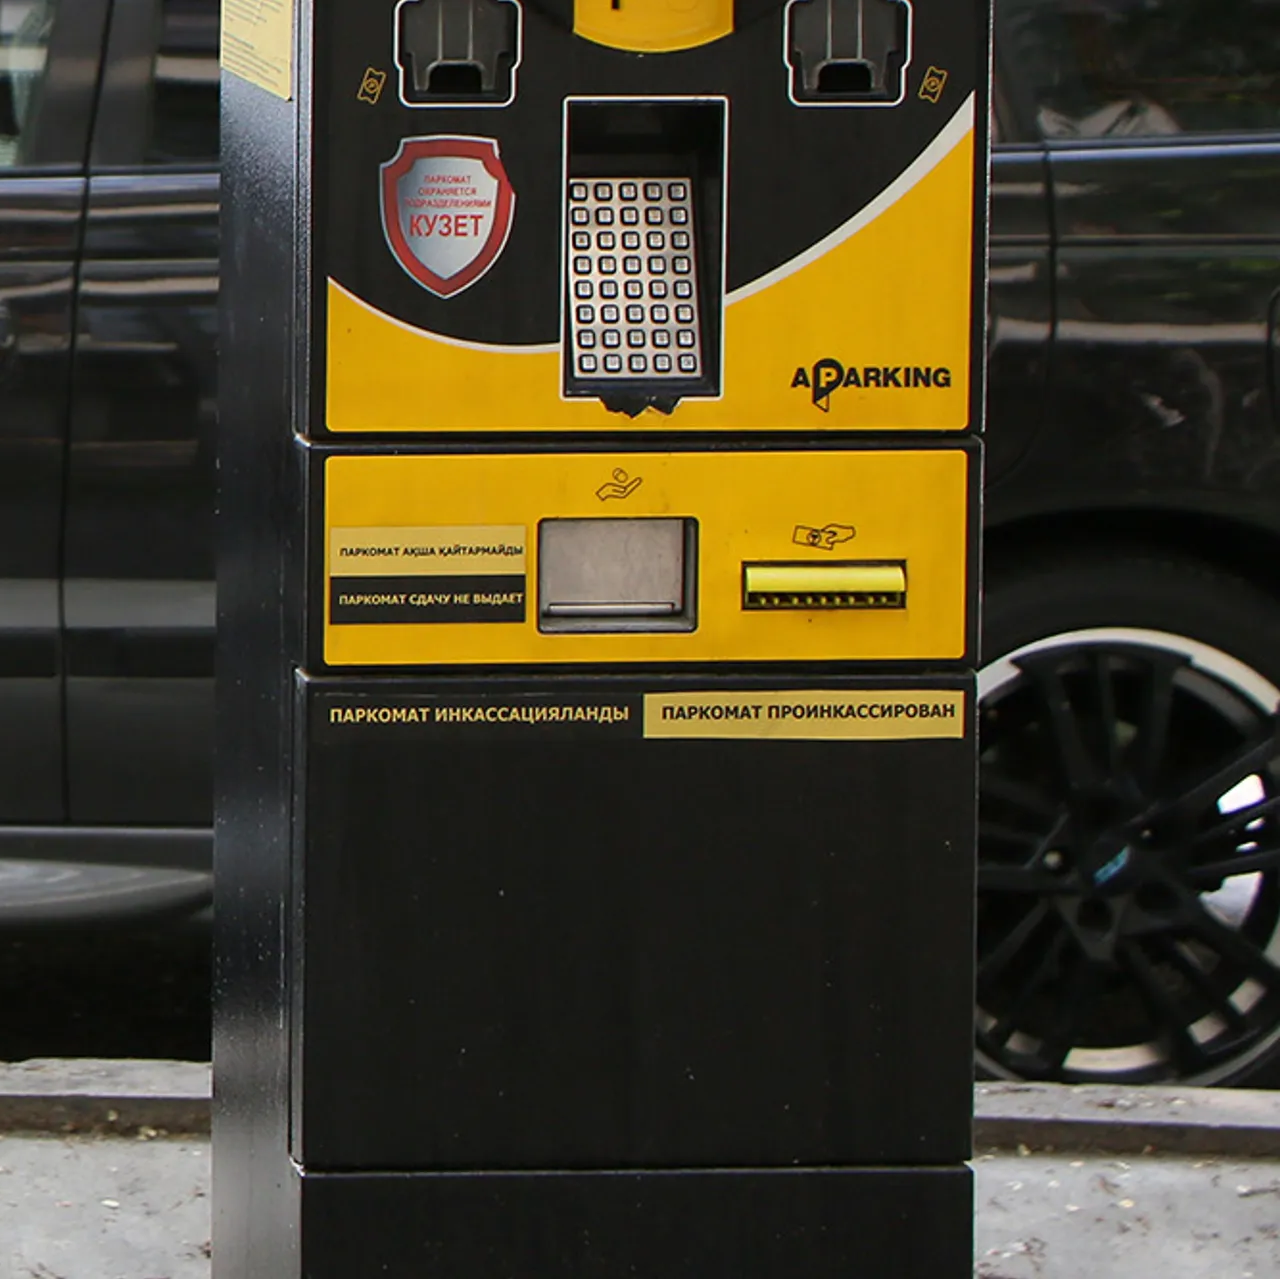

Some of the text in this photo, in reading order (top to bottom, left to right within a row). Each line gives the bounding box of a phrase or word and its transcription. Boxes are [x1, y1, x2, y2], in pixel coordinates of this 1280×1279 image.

[424, 174, 471, 184] ПАРКОМАТ
[791, 358, 952, 412] APARKING
[339, 544, 523, 558] ПАРКОМАТ АҚША ҚАЙТАРМАЙДЫ
[339, 592, 523, 606] ПАРКОМАТ СДАЧУ НЕ ВЫДАЕТ
[329, 706, 629, 723] ПАРКОМАТ ИНКАССАЦИЯЛАНДЫ
[662, 704, 955, 720] ПАРКОМАТ ПРОИНКАССИРОВАН
